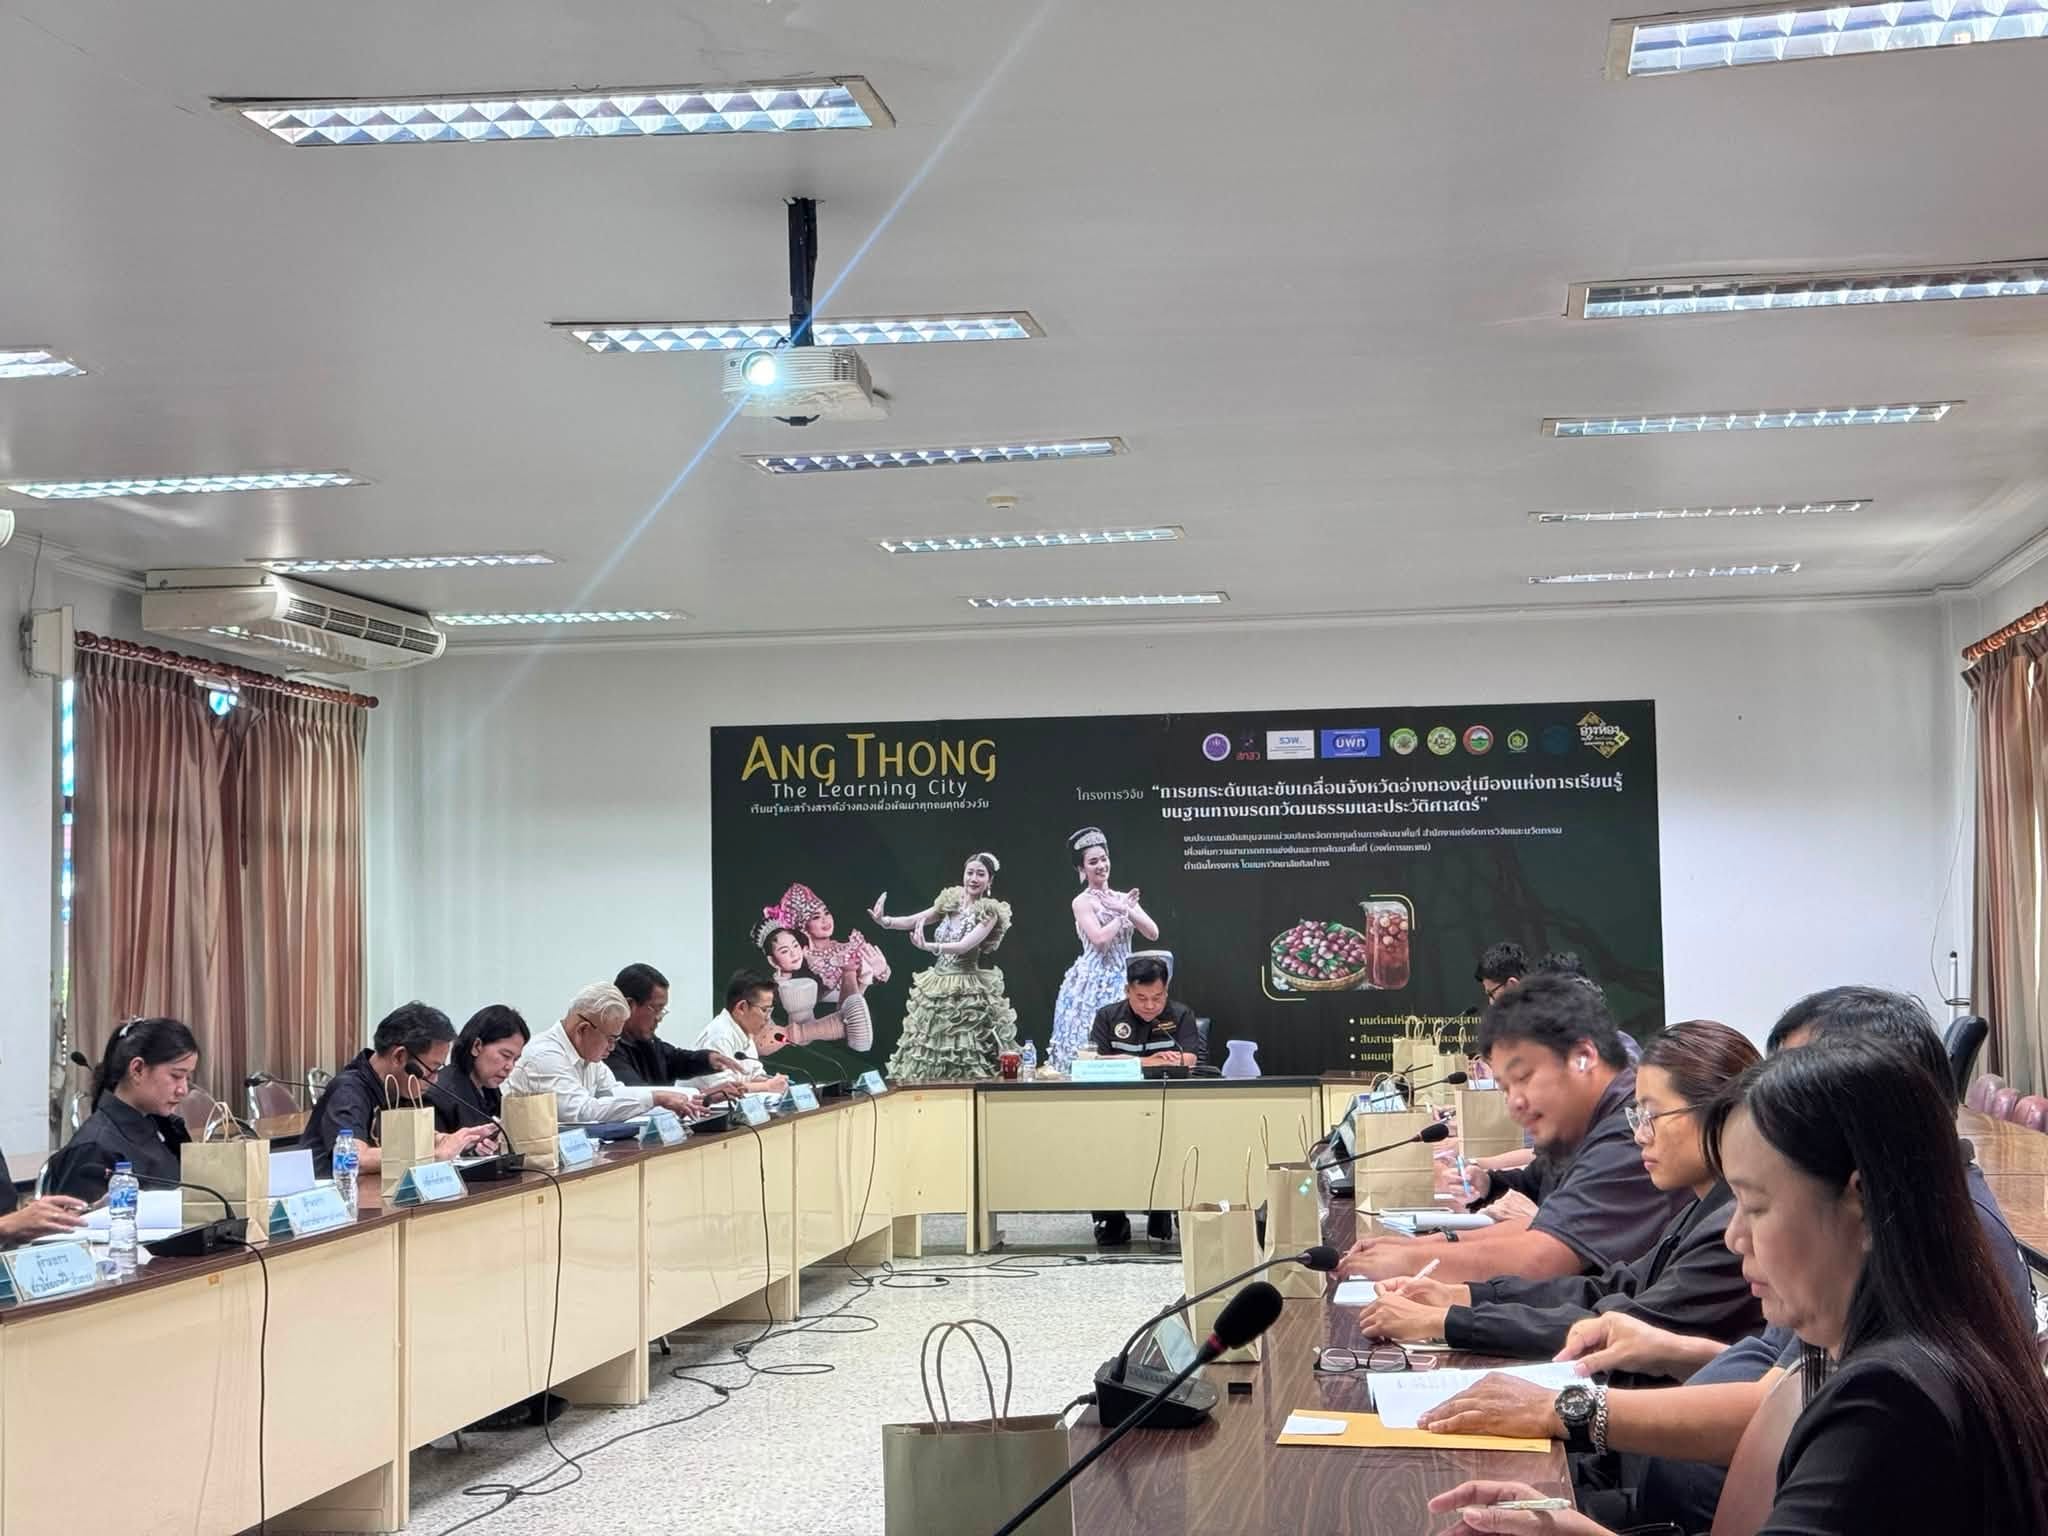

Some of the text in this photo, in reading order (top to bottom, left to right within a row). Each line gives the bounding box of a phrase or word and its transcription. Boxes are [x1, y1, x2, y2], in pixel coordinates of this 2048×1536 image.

[741, 731, 997, 787] ANG THONG
[771, 778, 968, 800] The Learning City
